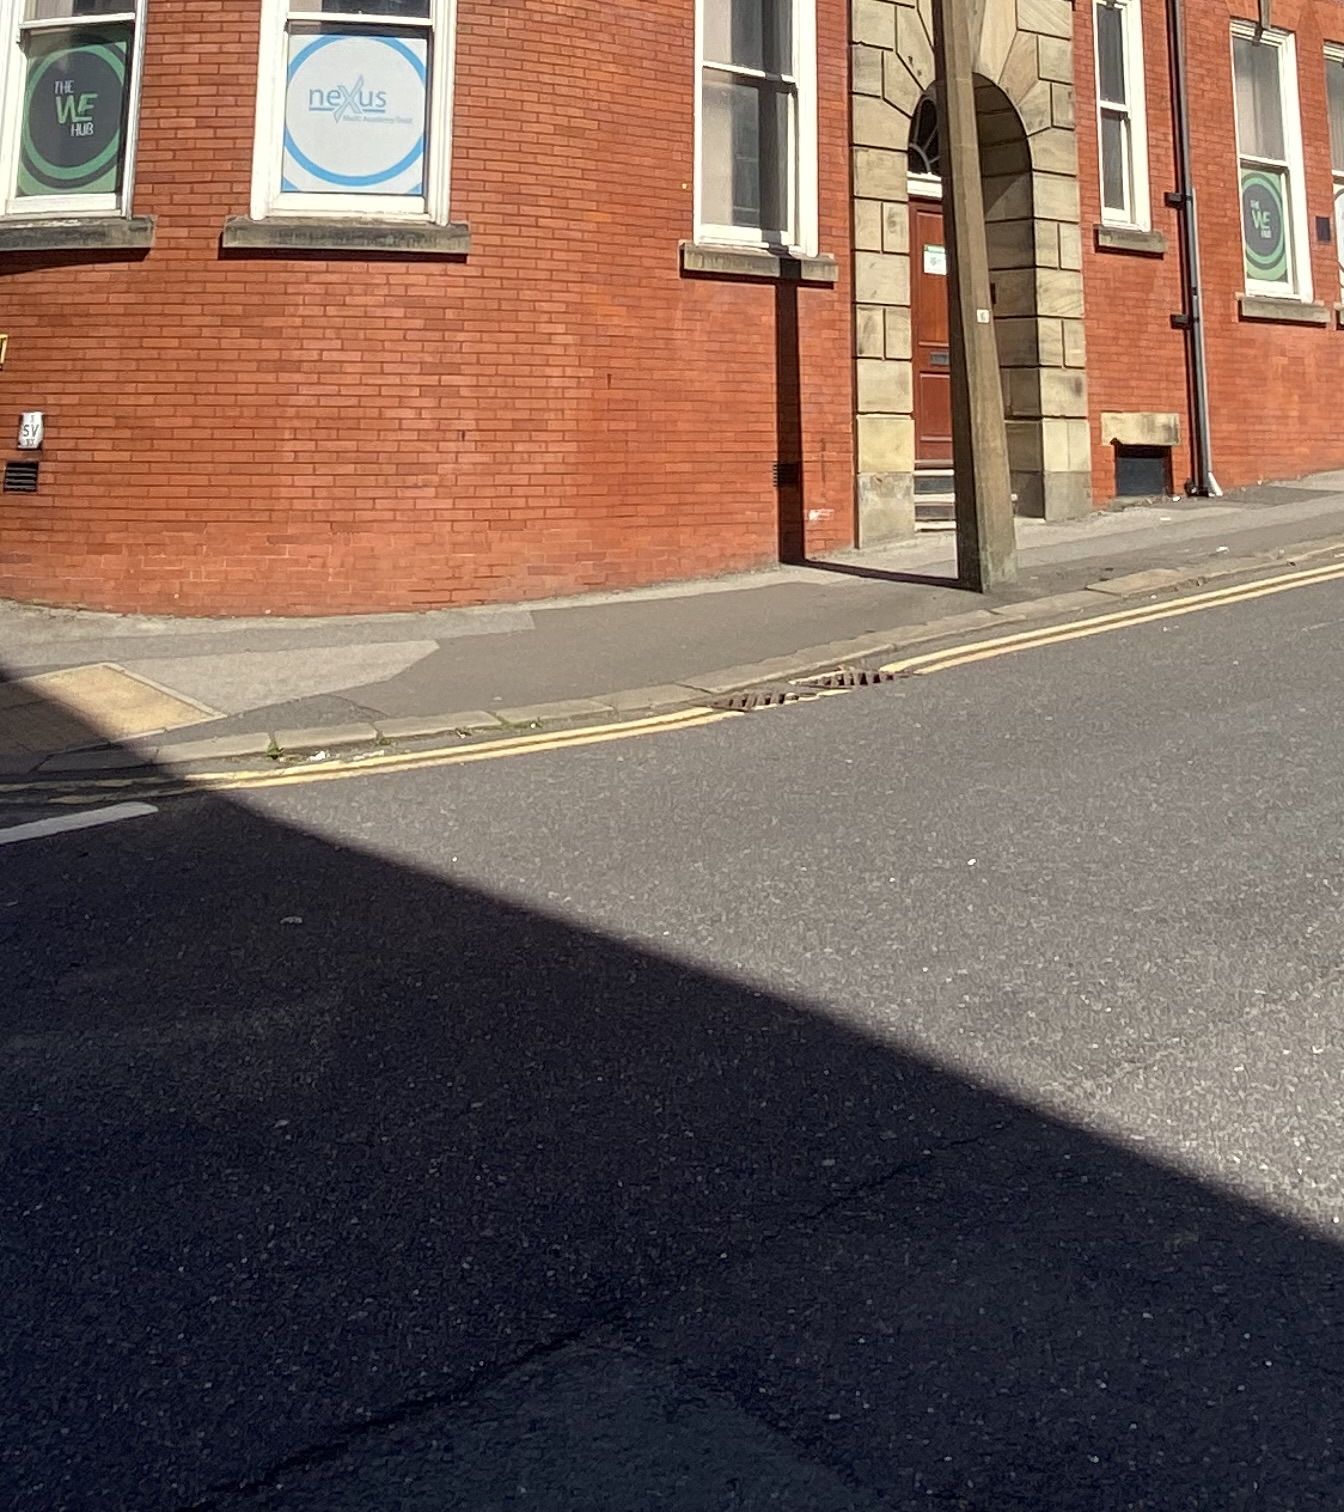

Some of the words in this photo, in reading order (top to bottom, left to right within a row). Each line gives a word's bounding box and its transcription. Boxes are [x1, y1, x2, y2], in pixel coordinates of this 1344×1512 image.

[54, 79, 75, 95] THE
[55, 93, 98, 124] WE
[70, 122, 94, 137] HUB
